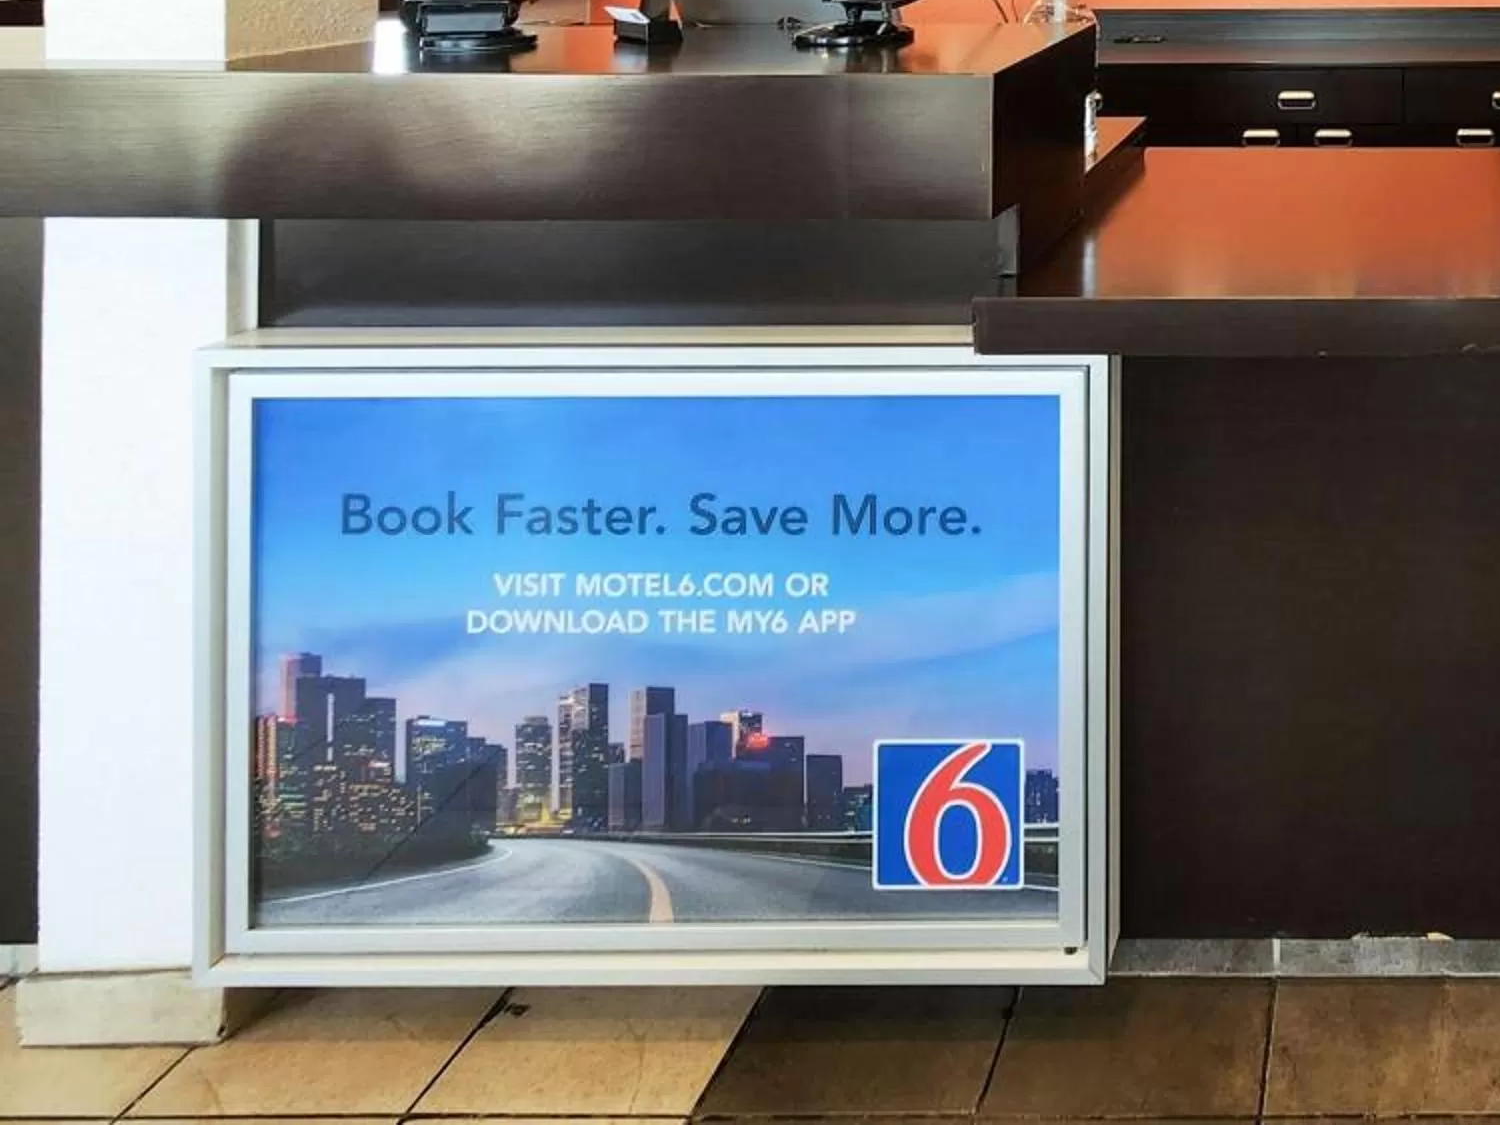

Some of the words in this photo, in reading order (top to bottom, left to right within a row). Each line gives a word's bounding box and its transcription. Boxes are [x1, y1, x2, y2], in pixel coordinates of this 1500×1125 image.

[340, 490, 473, 536] Book
[495, 494, 666, 536] Faster.
[688, 492, 808, 536] Save
[832, 493, 982, 536] More.
[494, 573, 565, 598] VISIT
[575, 573, 774, 598] MOTEL6.COM
[785, 573, 830, 597] OR
[466, 610, 650, 635] DOWNLOAD
[659, 610, 717, 635] THE
[727, 610, 789, 635] MY6
[799, 610, 857, 635] APP
[903, 740, 1013, 889] 6
